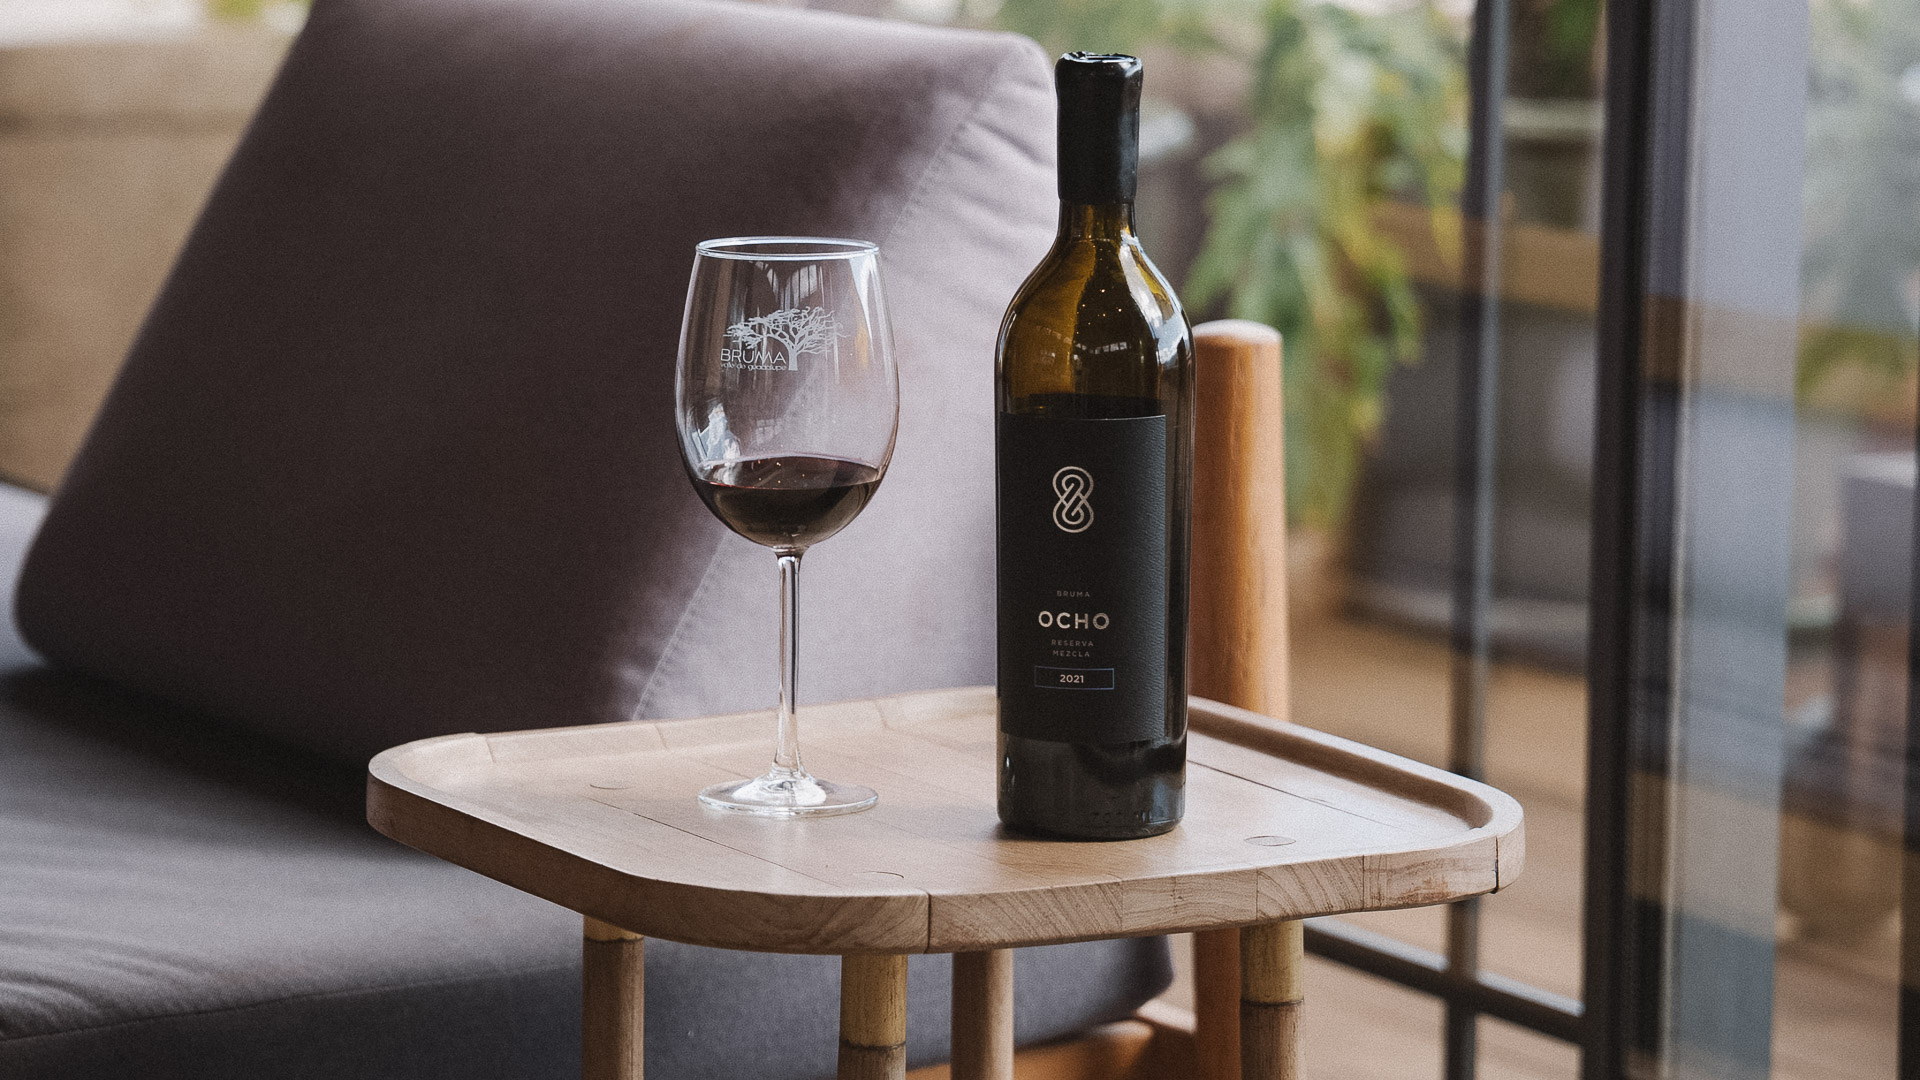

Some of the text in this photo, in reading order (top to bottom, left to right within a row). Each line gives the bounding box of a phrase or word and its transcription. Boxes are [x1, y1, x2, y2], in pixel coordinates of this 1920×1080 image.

[720, 348, 787, 364] BRUMA
[1056, 590, 1091, 598] BRUMA
[1038, 610, 1110, 630] OCHO
[1051, 639, 1094, 647] RESERVA
[1059, 674, 1085, 684] 2021
